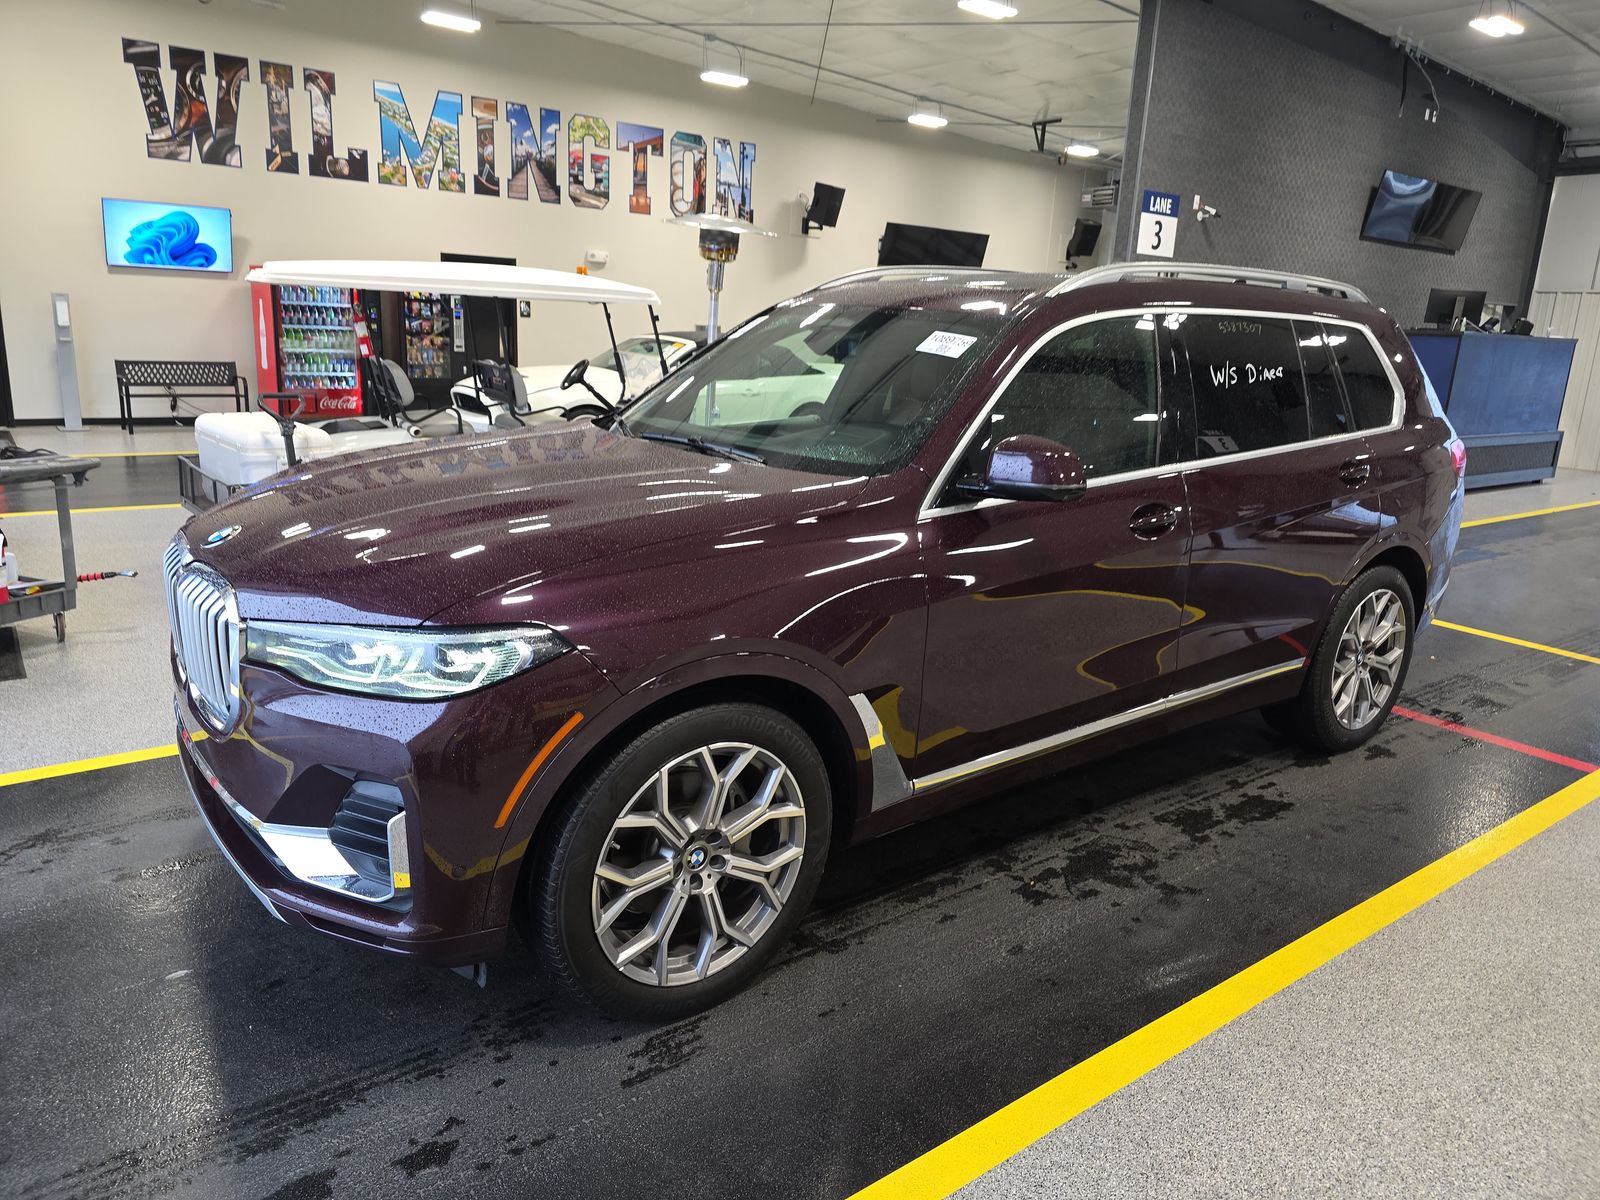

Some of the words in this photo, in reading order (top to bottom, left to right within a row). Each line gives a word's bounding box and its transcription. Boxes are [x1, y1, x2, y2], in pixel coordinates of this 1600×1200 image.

[121, 37, 757, 224] WILMINGTON
[1150, 195, 1172, 214] LANE
[1151, 220, 1163, 250] 3
[1209, 360, 1238, 389] W/S
